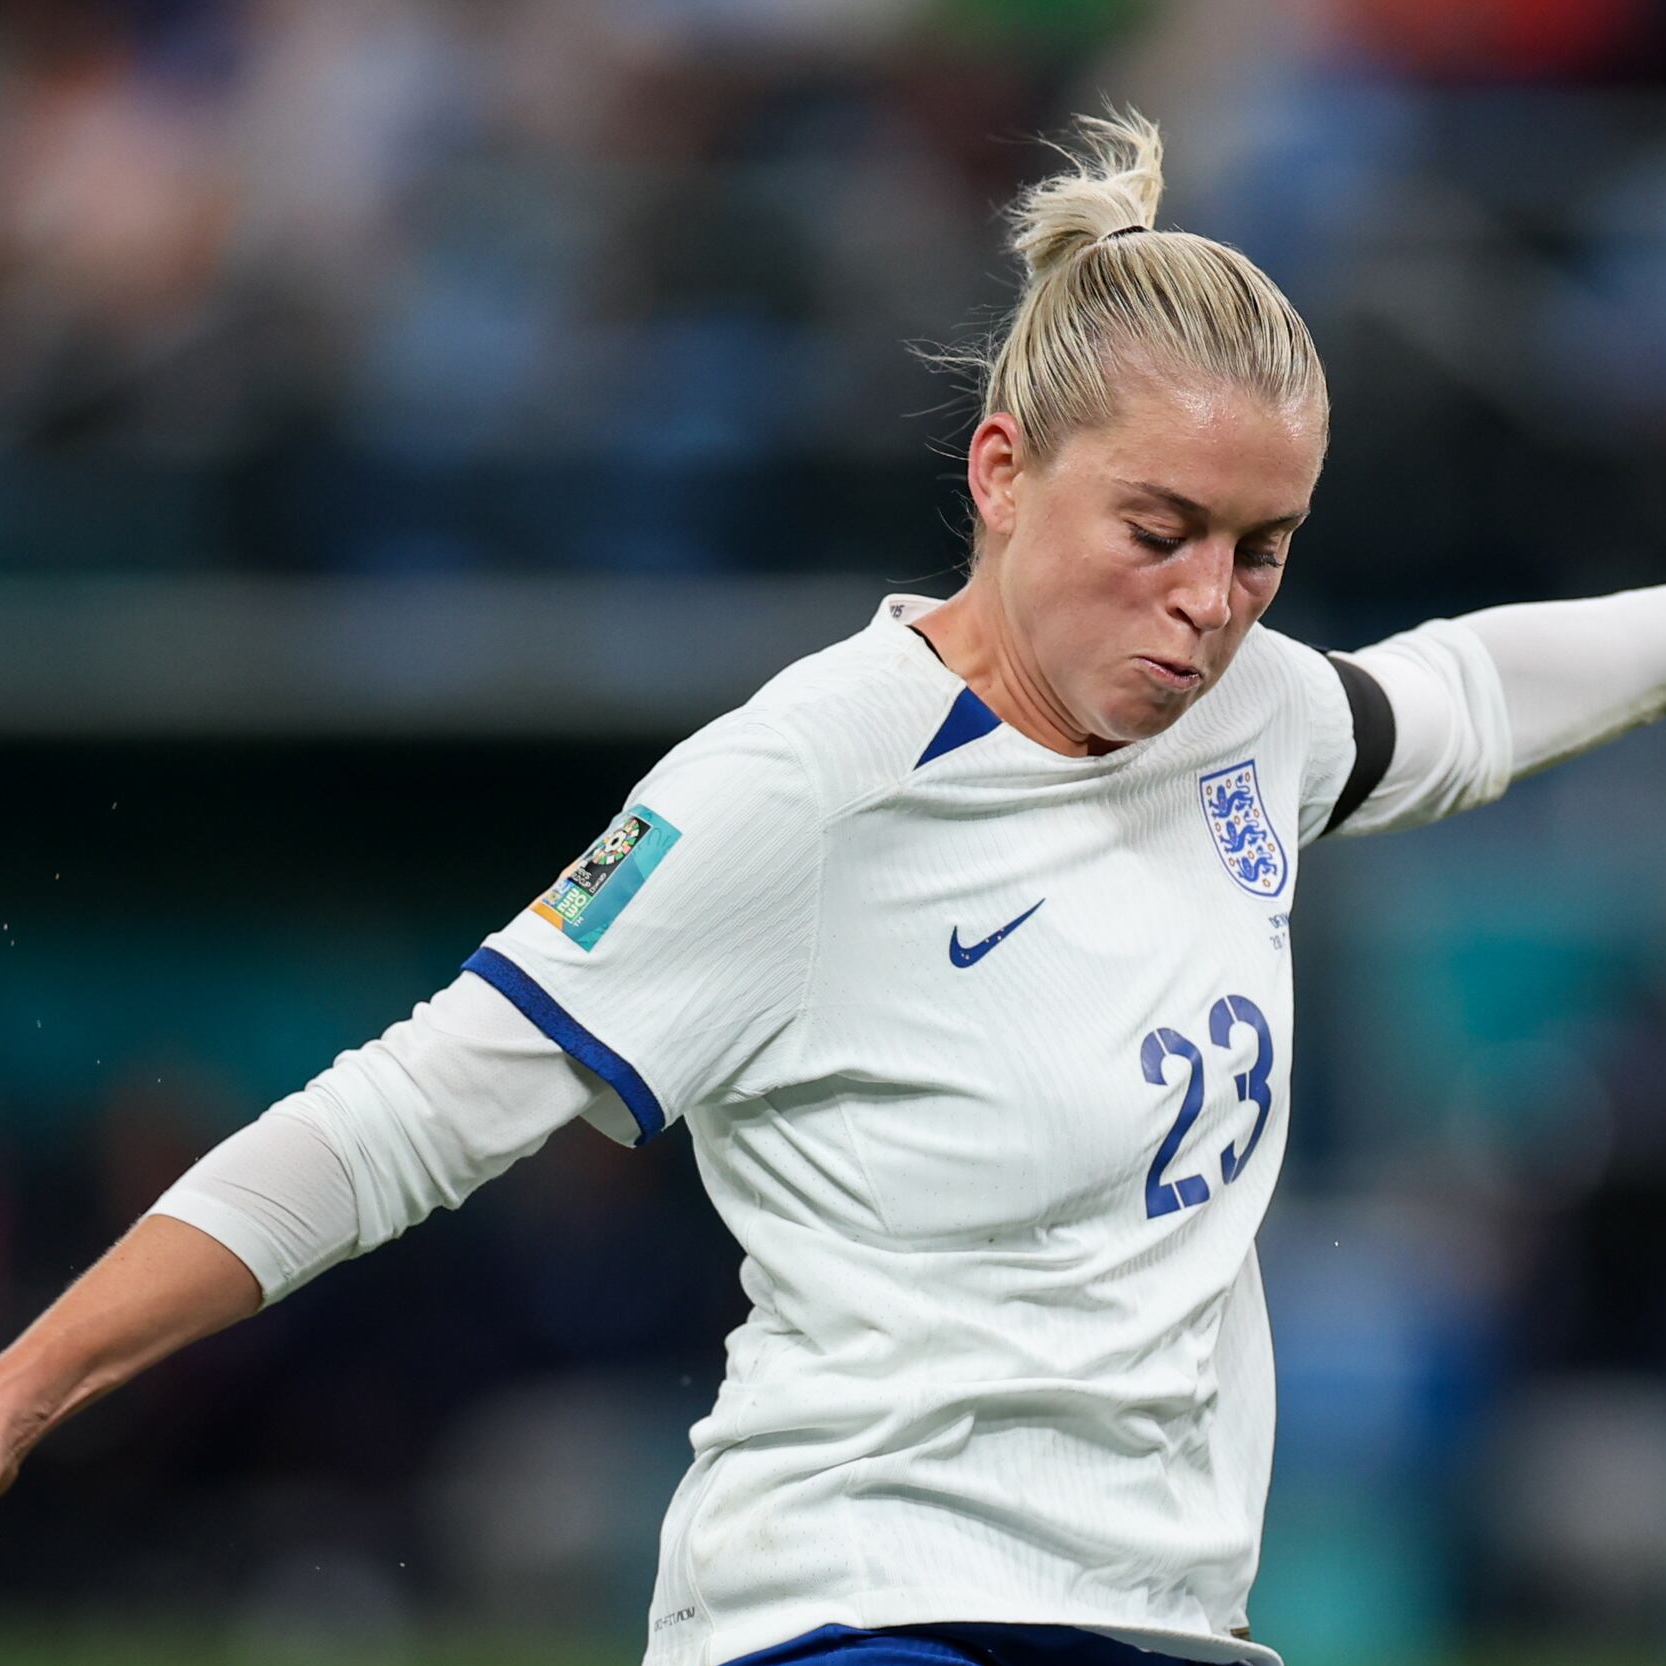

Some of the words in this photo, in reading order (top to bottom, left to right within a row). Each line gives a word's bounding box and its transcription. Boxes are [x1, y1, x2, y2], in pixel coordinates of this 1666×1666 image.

[566, 887, 587, 908] 20
[556, 898, 579, 919] 23
[1140, 994, 1274, 1220] 23
